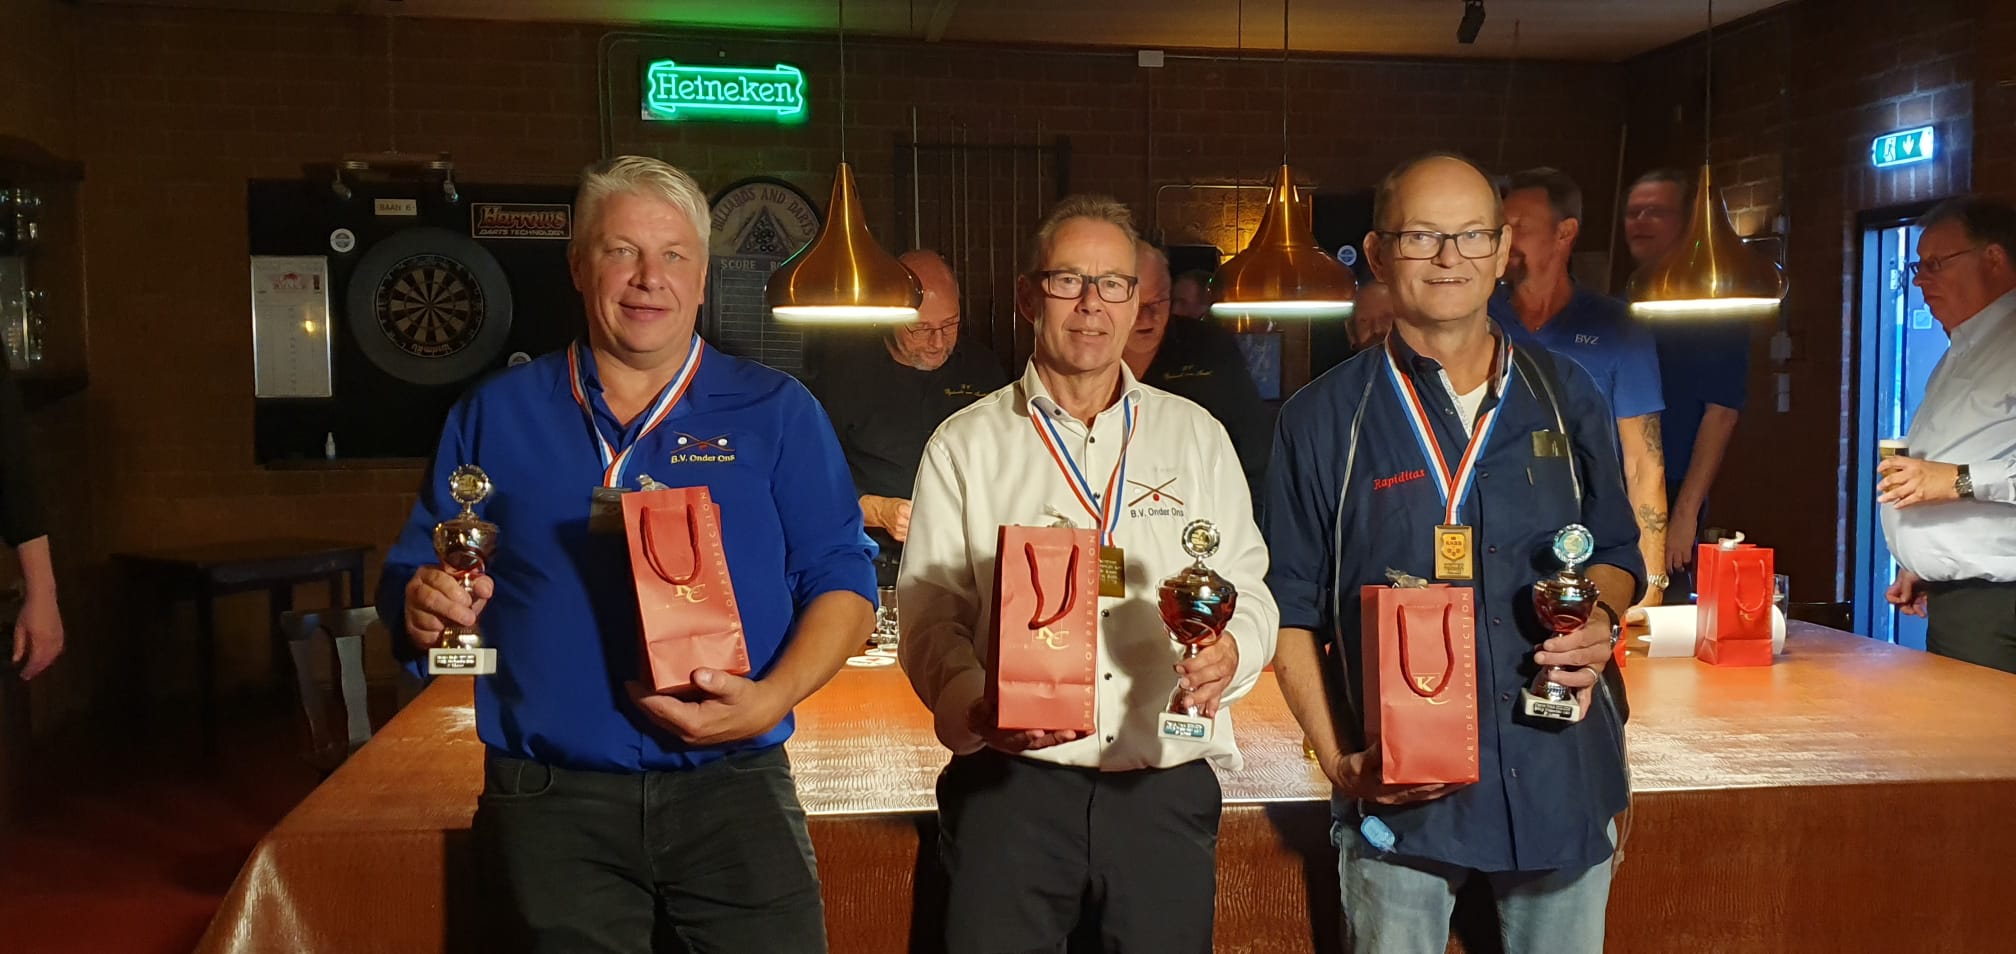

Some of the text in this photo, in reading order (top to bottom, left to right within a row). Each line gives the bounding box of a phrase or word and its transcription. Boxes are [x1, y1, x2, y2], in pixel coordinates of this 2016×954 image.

[656, 73, 795, 103] Heineken
[479, 206, 566, 229] Harrows
[711, 187, 816, 237] BILLIARDS AND DARTS
[720, 258, 757, 270] SCORE
[1575, 334, 1600, 345] BVZ
[689, 454, 716, 462] Onder
[717, 454, 736, 462] Ons
[1148, 507, 1169, 516] Onder
[1171, 507, 1184, 517] Ons
